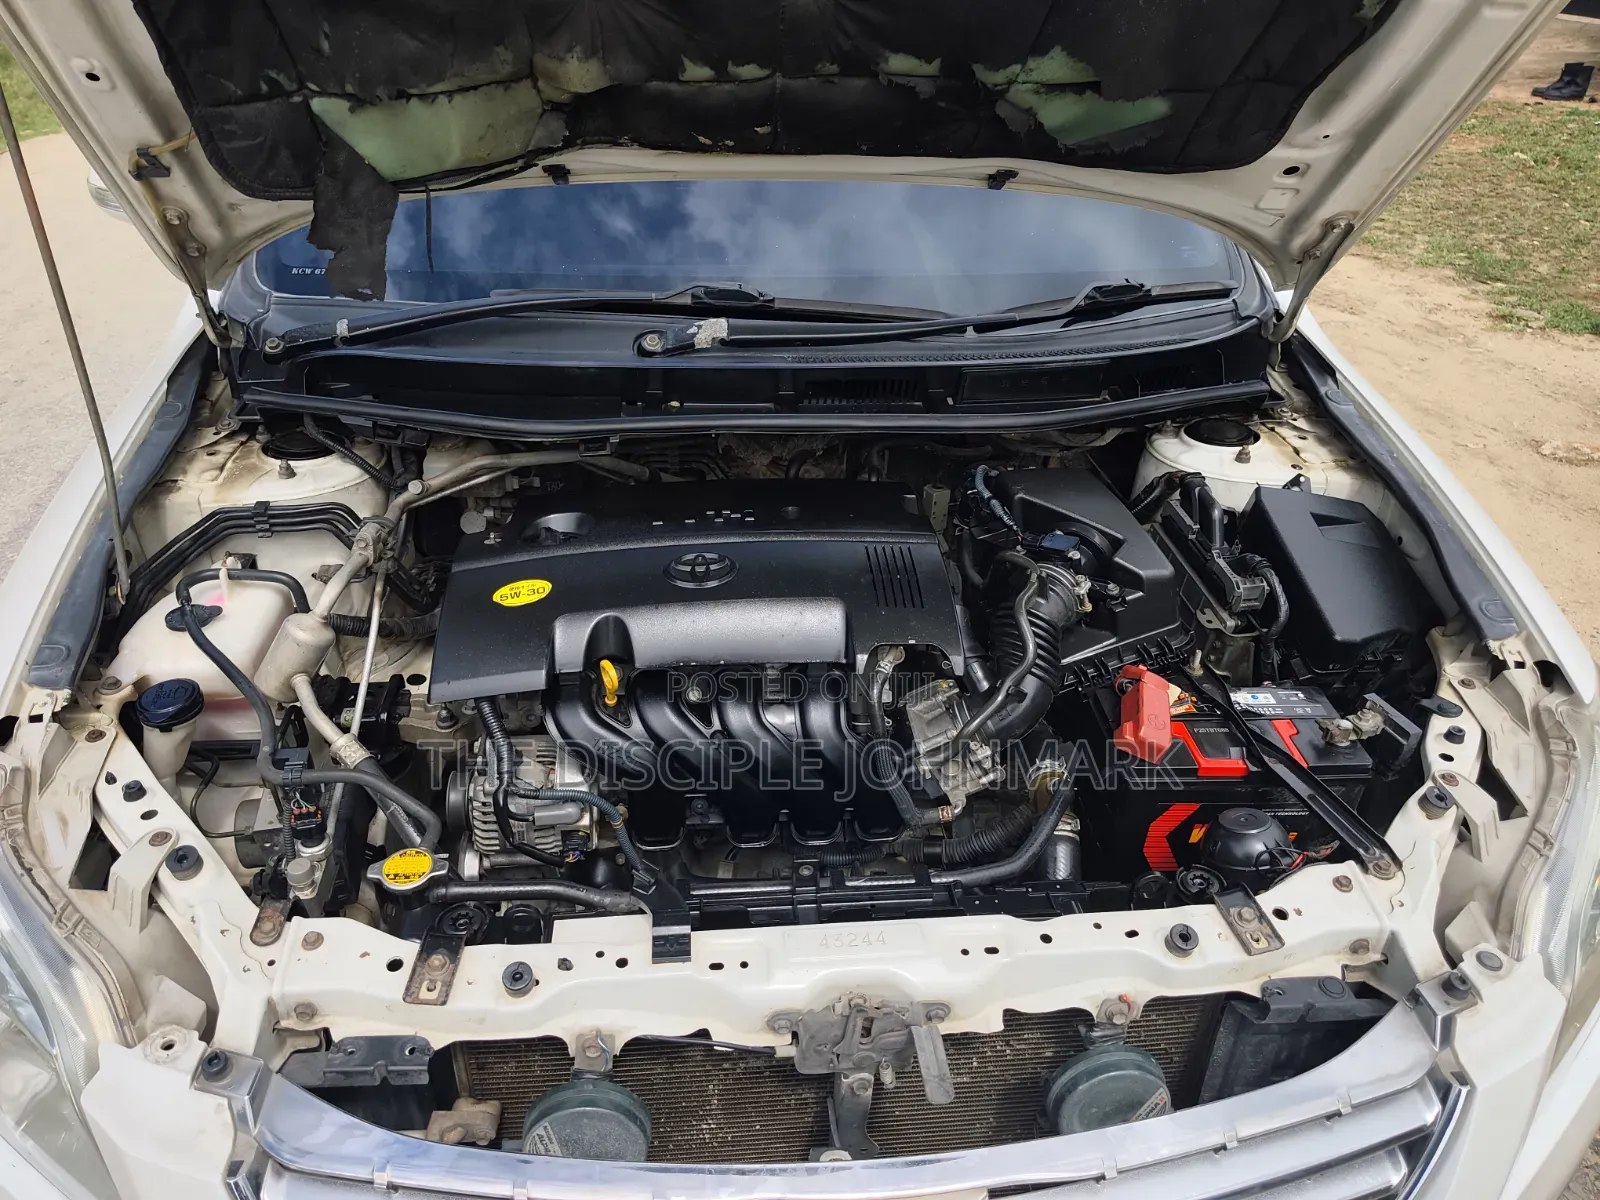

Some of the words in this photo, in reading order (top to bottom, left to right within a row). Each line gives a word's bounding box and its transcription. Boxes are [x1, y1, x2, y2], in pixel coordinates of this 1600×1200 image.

[291, 267, 313, 275] KCW
[499, 586, 546, 602] 5W-30
[818, 930, 888, 949] 43244
